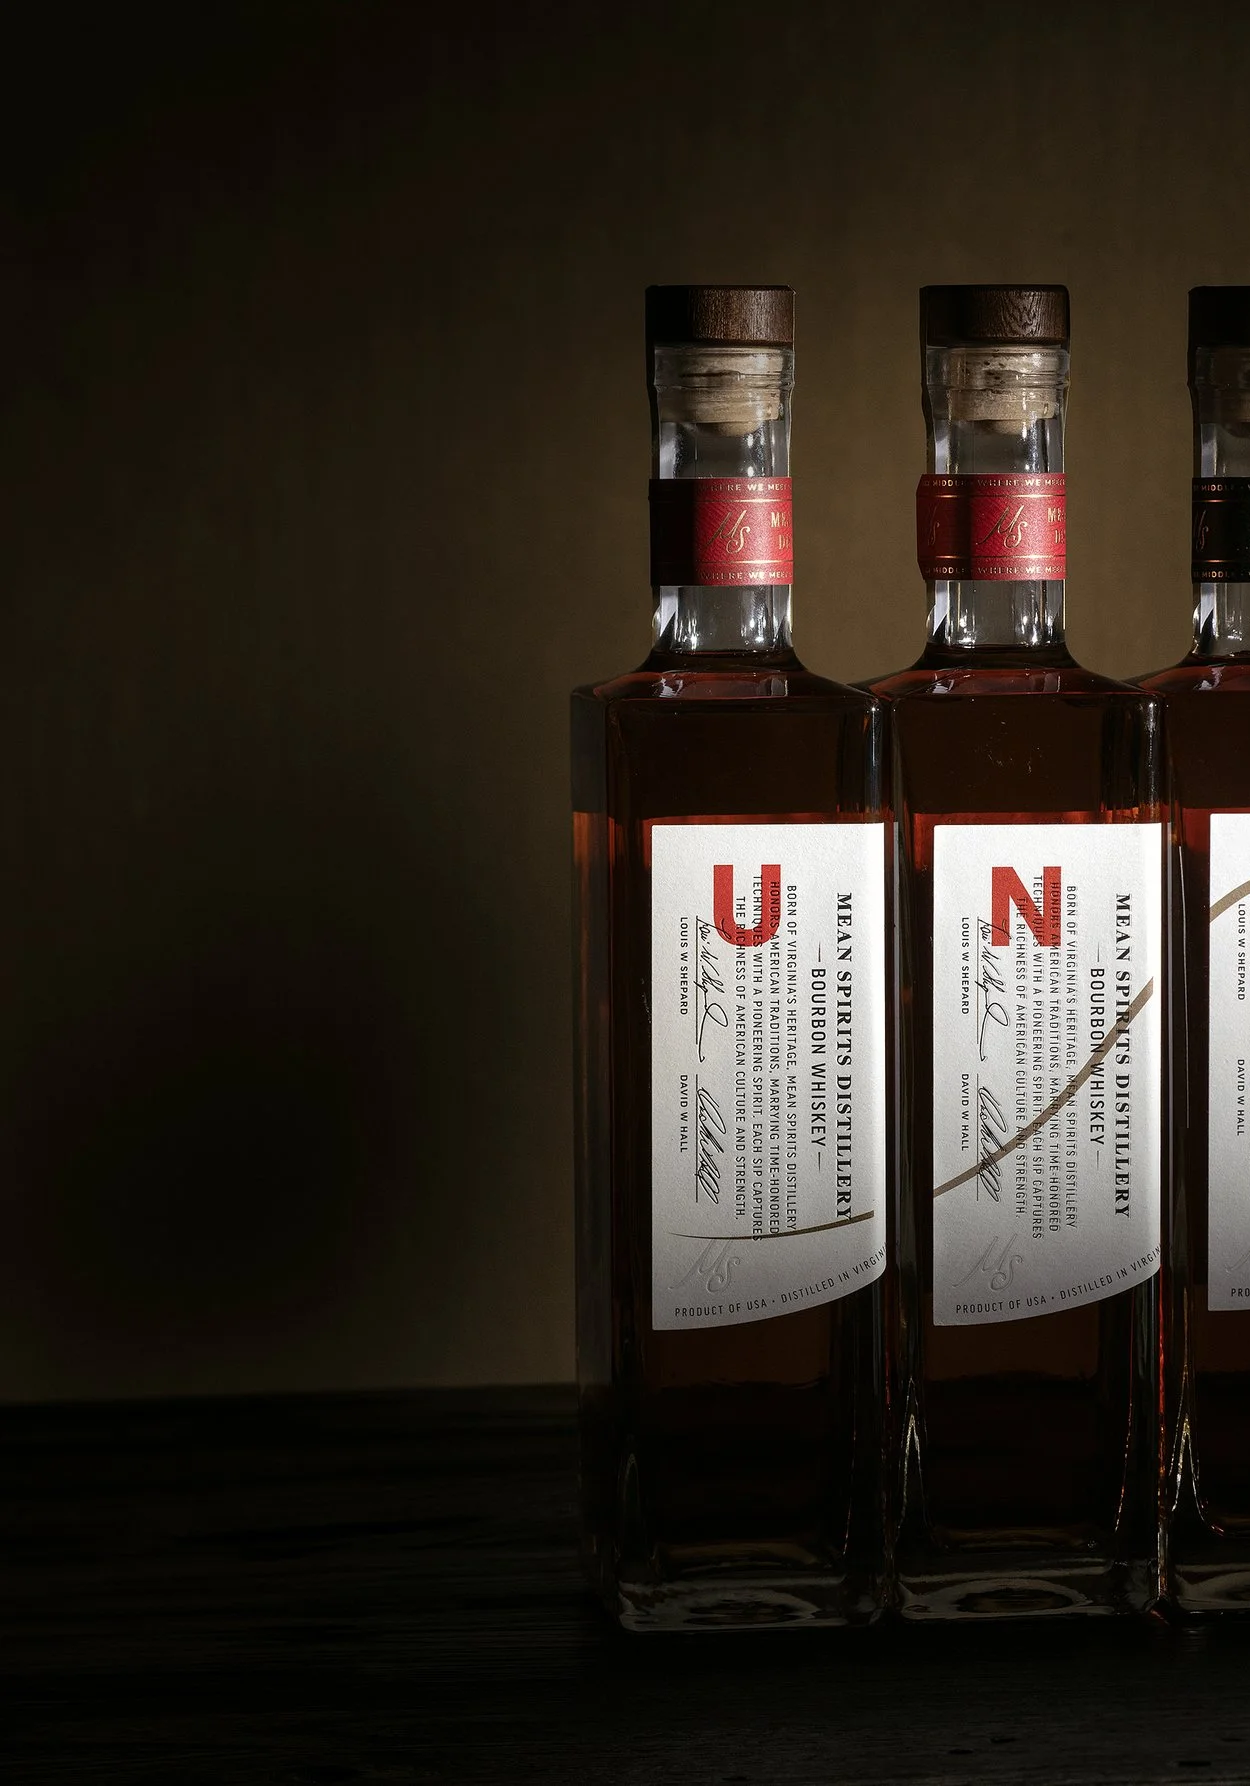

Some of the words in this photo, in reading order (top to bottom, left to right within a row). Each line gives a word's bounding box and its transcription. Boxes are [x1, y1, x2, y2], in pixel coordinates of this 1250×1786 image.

[714, 864, 782, 947] U
[735, 895, 746, 919] THE
[752, 874, 764, 948] TECHNIQUES
[769, 881, 781, 931] HONORS
[786, 885, 797, 916] BORN
[992, 866, 1061, 947] N
[1237, 903, 1246, 935] LOUIS
[679, 916, 689, 949] LOUIS
[735, 923, 747, 981] RICHNESS
[786, 921, 797, 936] OF
[836, 892, 853, 963] MEAN
[961, 917, 970, 948] LOUIS
[1115, 893, 1131, 962] MEAN
[1237, 937, 1246, 949] W
[680, 951, 689, 963] W
[752, 952, 763, 983] WITH
[769, 934, 780, 997] AMERICAN
[786, 940, 797, 1005] VIRGINIA'S
[961, 951, 970, 962] W
[1237, 951, 1246, 1001] SHEPARD
[679, 965, 689, 1015] SHEPARD
[735, 985, 746, 1000] OF
[752, 987, 763, 996] A
[811, 968, 827, 1055] BOURBON
[961, 965, 970, 1015] SHEPARD
[1089, 968, 1105, 1054] BOURBON
[735, 1004, 746, 1066] AMERICAN
[752, 1000, 763, 1073] PIONEERING
[768, 1000, 780, 1076] TRADITIONS,
[786, 1009, 797, 1071] HERITAGE,
[836, 970, 852, 1067] SPIRITS
[1115, 970, 1131, 1065] SPIRITS
[679, 1074, 689, 1108] DAVID
[735, 1070, 746, 1123] CULTURE
[751, 1076, 763, 1119] SPIRIT.
[786, 1075, 797, 1111] MEAN
[961, 1073, 970, 1107] DAVID
[1237, 1059, 1245, 1092] DAVID
[1237, 1095, 1245, 1106] W
[680, 1111, 689, 1122] W
[769, 1080, 780, 1143] MARRYING
[811, 1062, 827, 1147] WHISKEY
[961, 1110, 970, 1121] W
[1089, 1061, 1105, 1145] WHISKEY
[1236, 1109, 1245, 1137] HALL
[679, 1125, 689, 1153] HALL
[735, 1126, 746, 1152] AND
[751, 1123, 763, 1153] EACH
[785, 1115, 797, 1163] SPIRITS
[836, 1074, 853, 1224] DISTILLERY
[961, 1124, 969, 1152] HALL
[1115, 1073, 1130, 1219] DISTILLERY
[735, 1155, 746, 1220] STRENGTH.
[752, 1157, 763, 1177] SIP
[768, 1146, 781, 1237] TIME-HONORED
[751, 1181, 764, 1242] CAPTURES
[785, 1165, 798, 1232] DISTILLERY
[675, 1307, 723, 1317] PRODUCT
[728, 1303, 741, 1313] OF
[746, 1298, 768, 1310] USA
[780, 1278, 835, 1303] DISTILLED
[838, 1271, 850, 1283] IN
[956, 1301, 1004, 1314] PRODUCT
[1008, 1299, 1021, 1310] OF
[1026, 1295, 1047, 1307] USA
[1059, 1274, 1113, 1300] DISTILLED
[1116, 1268, 1128, 1280] IN
